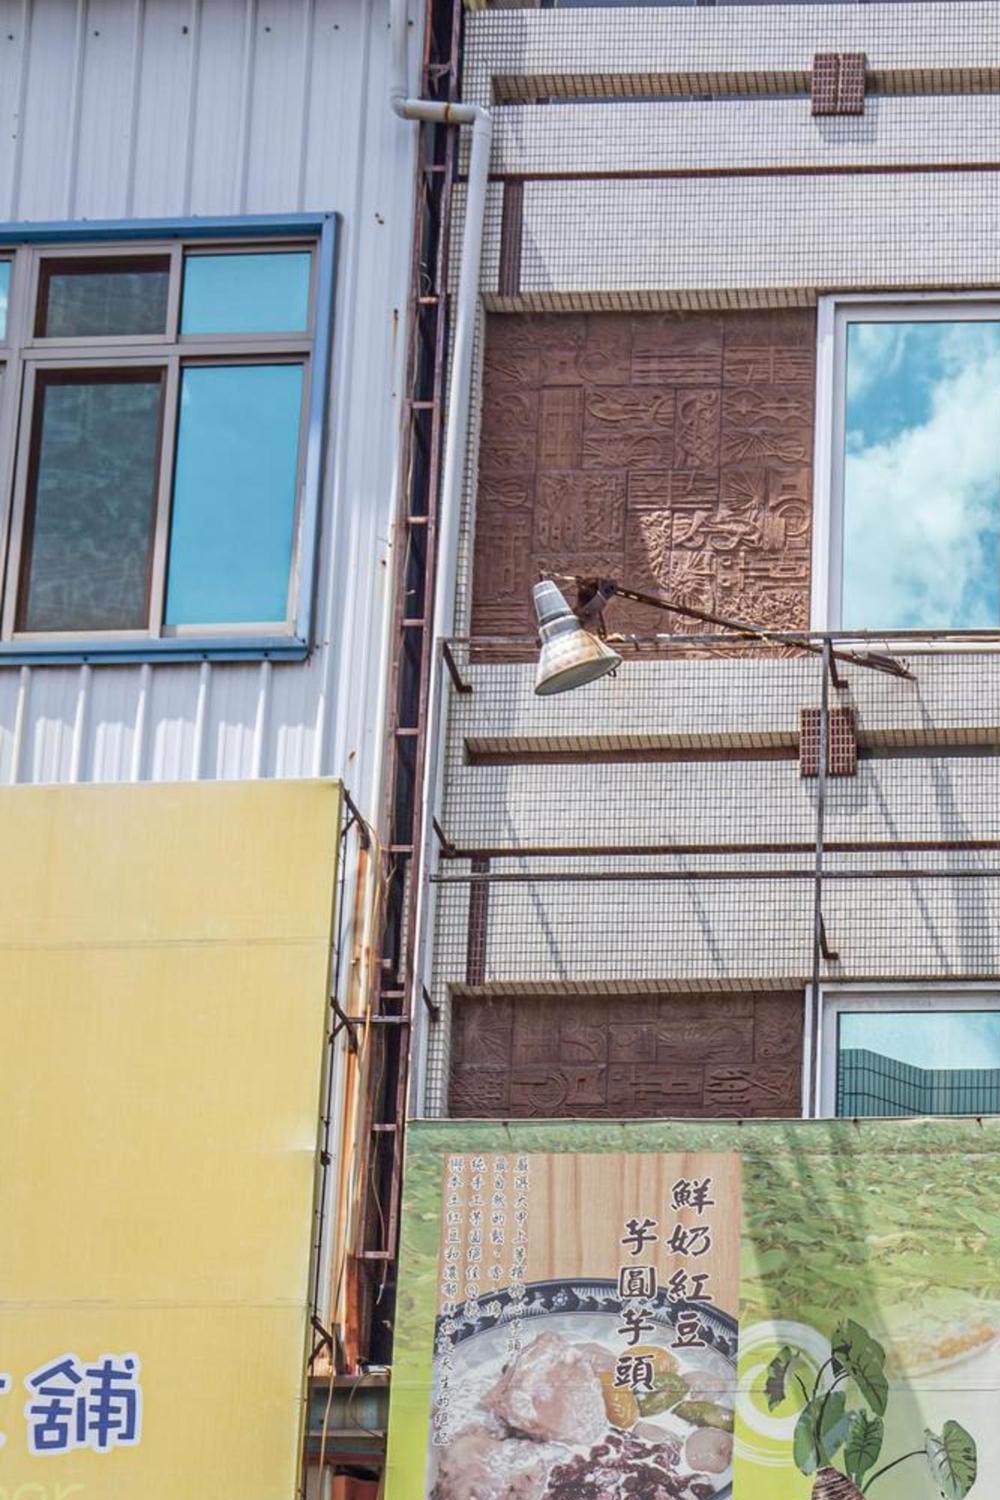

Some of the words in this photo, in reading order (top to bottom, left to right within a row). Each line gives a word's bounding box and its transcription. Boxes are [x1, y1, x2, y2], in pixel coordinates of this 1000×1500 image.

[613, 1219, 657, 1390] 芋圓芋頭
[666, 1178, 715, 1349] 鮮奶紅豆
